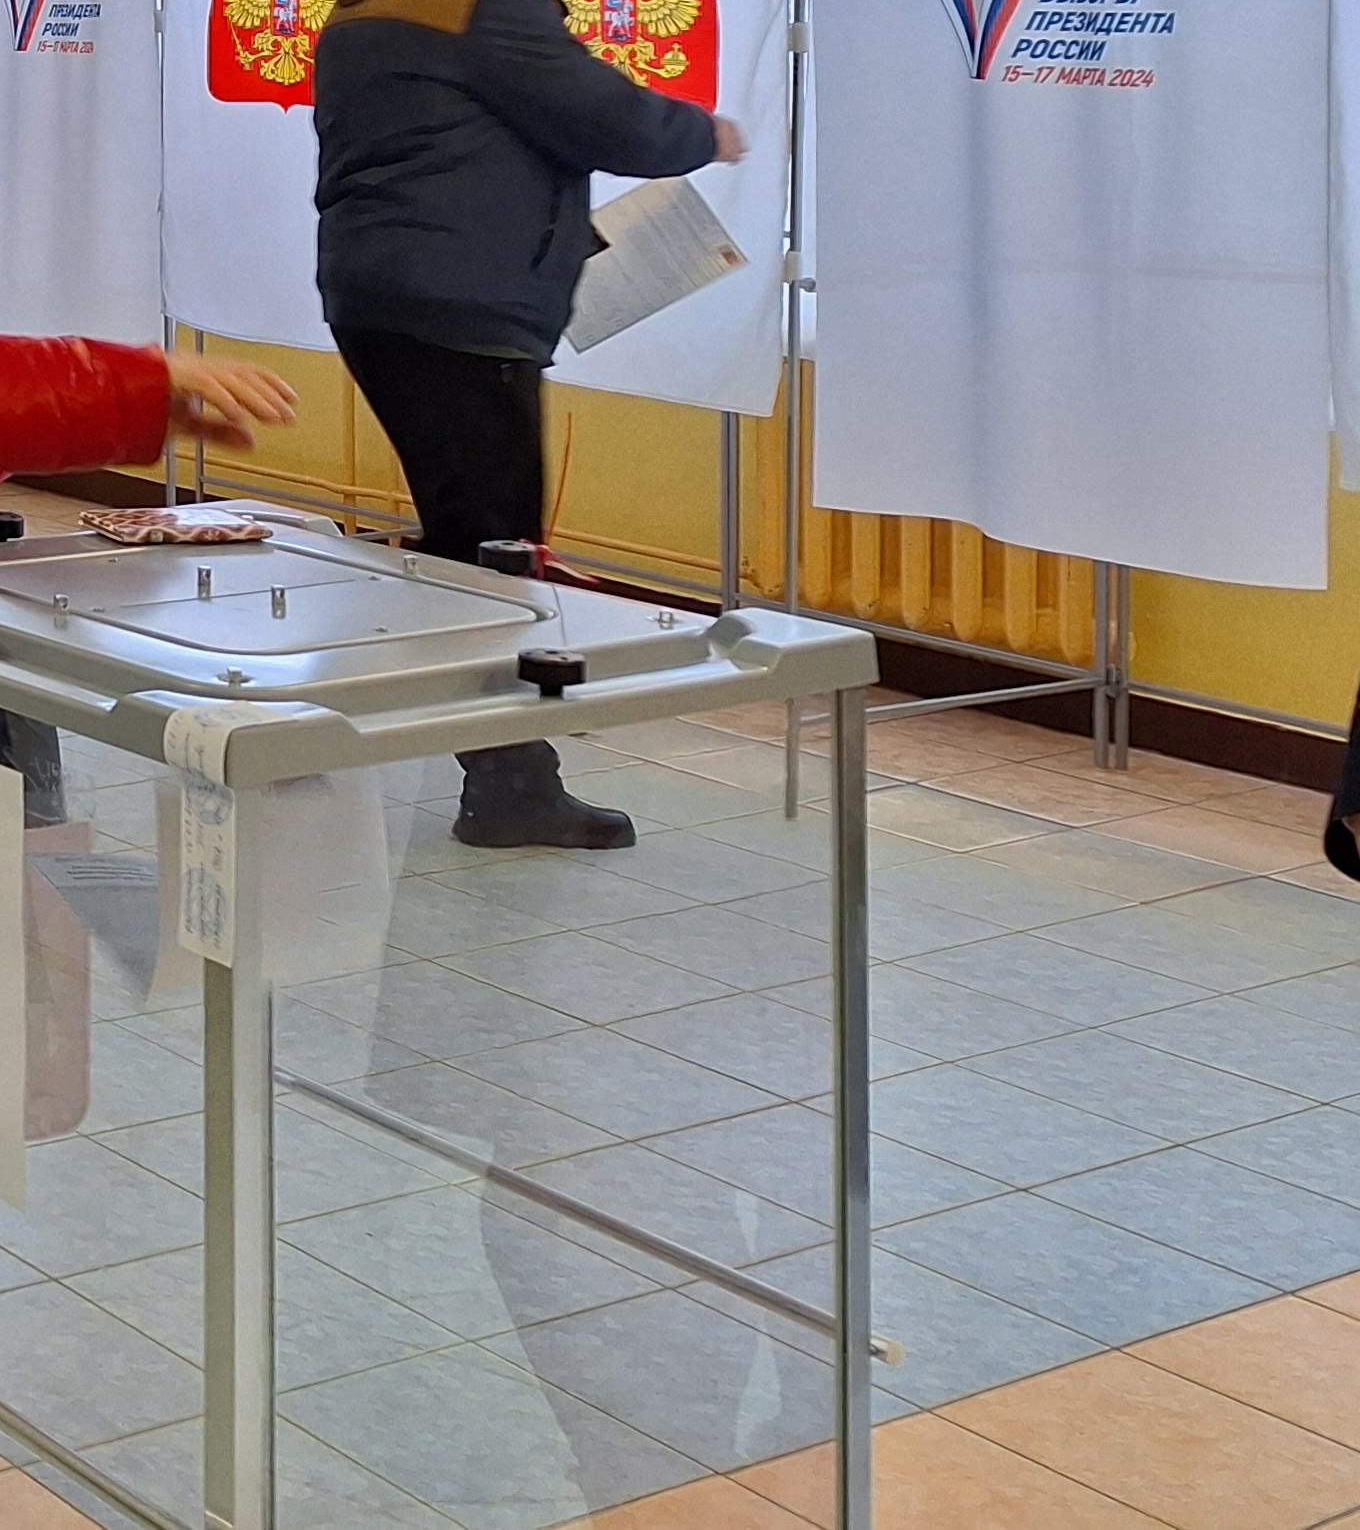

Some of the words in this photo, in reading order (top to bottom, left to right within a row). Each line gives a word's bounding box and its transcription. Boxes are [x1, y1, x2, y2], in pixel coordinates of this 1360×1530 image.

[1024, 10, 1176, 35] ПРЕЗИДЕНТА
[1011, 38, 1107, 61] РОССИИ
[1055, 67, 1105, 87] МАРТА
[1107, 69, 1155, 88] 2024
